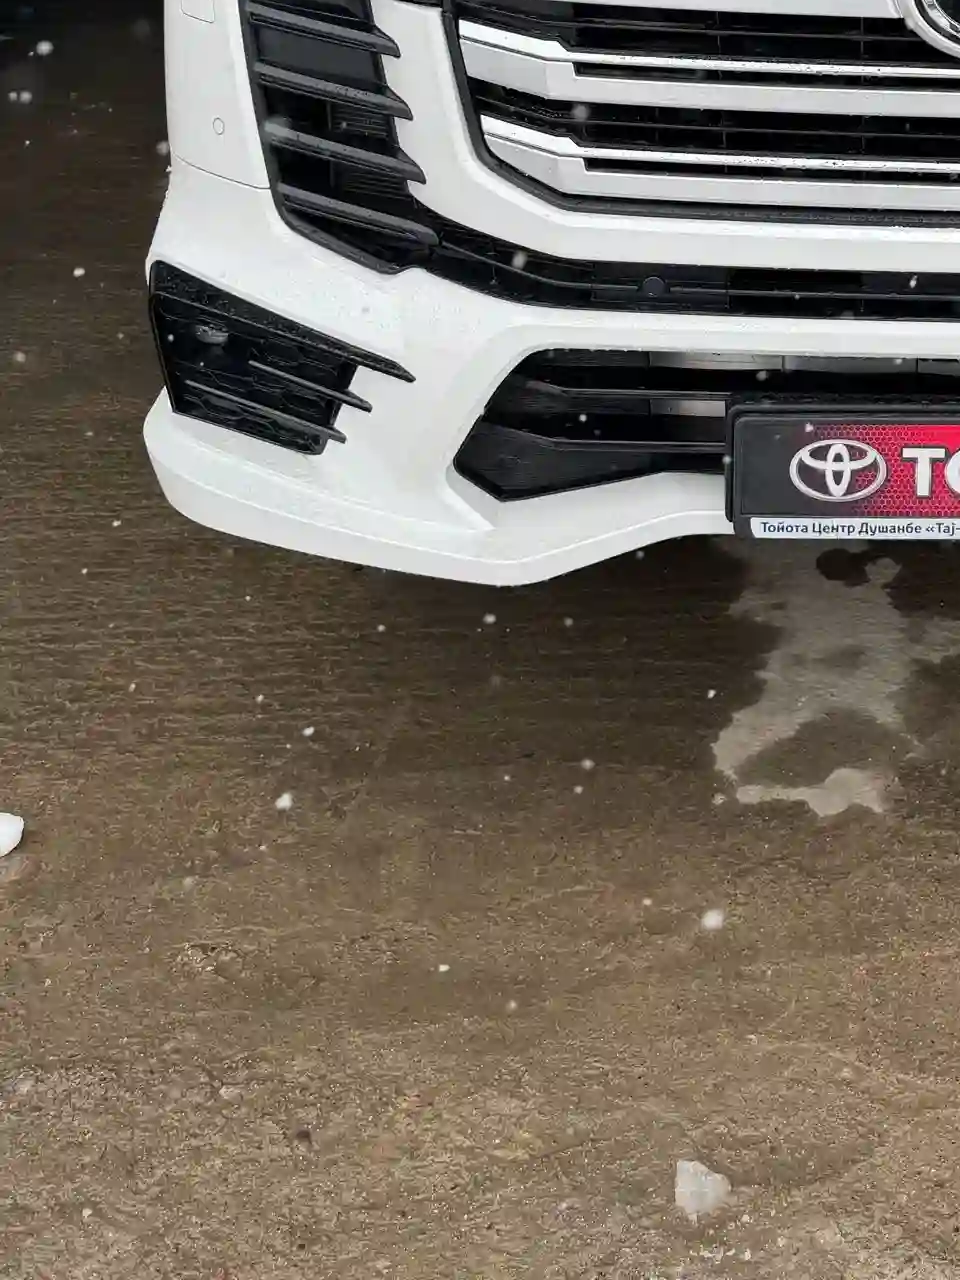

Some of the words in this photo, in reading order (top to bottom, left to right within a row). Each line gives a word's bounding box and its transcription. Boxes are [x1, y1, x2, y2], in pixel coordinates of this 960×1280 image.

[761, 521, 808, 534] Тойота
[812, 522, 856, 536] Центр
[858, 521, 922, 535] Душанбе
